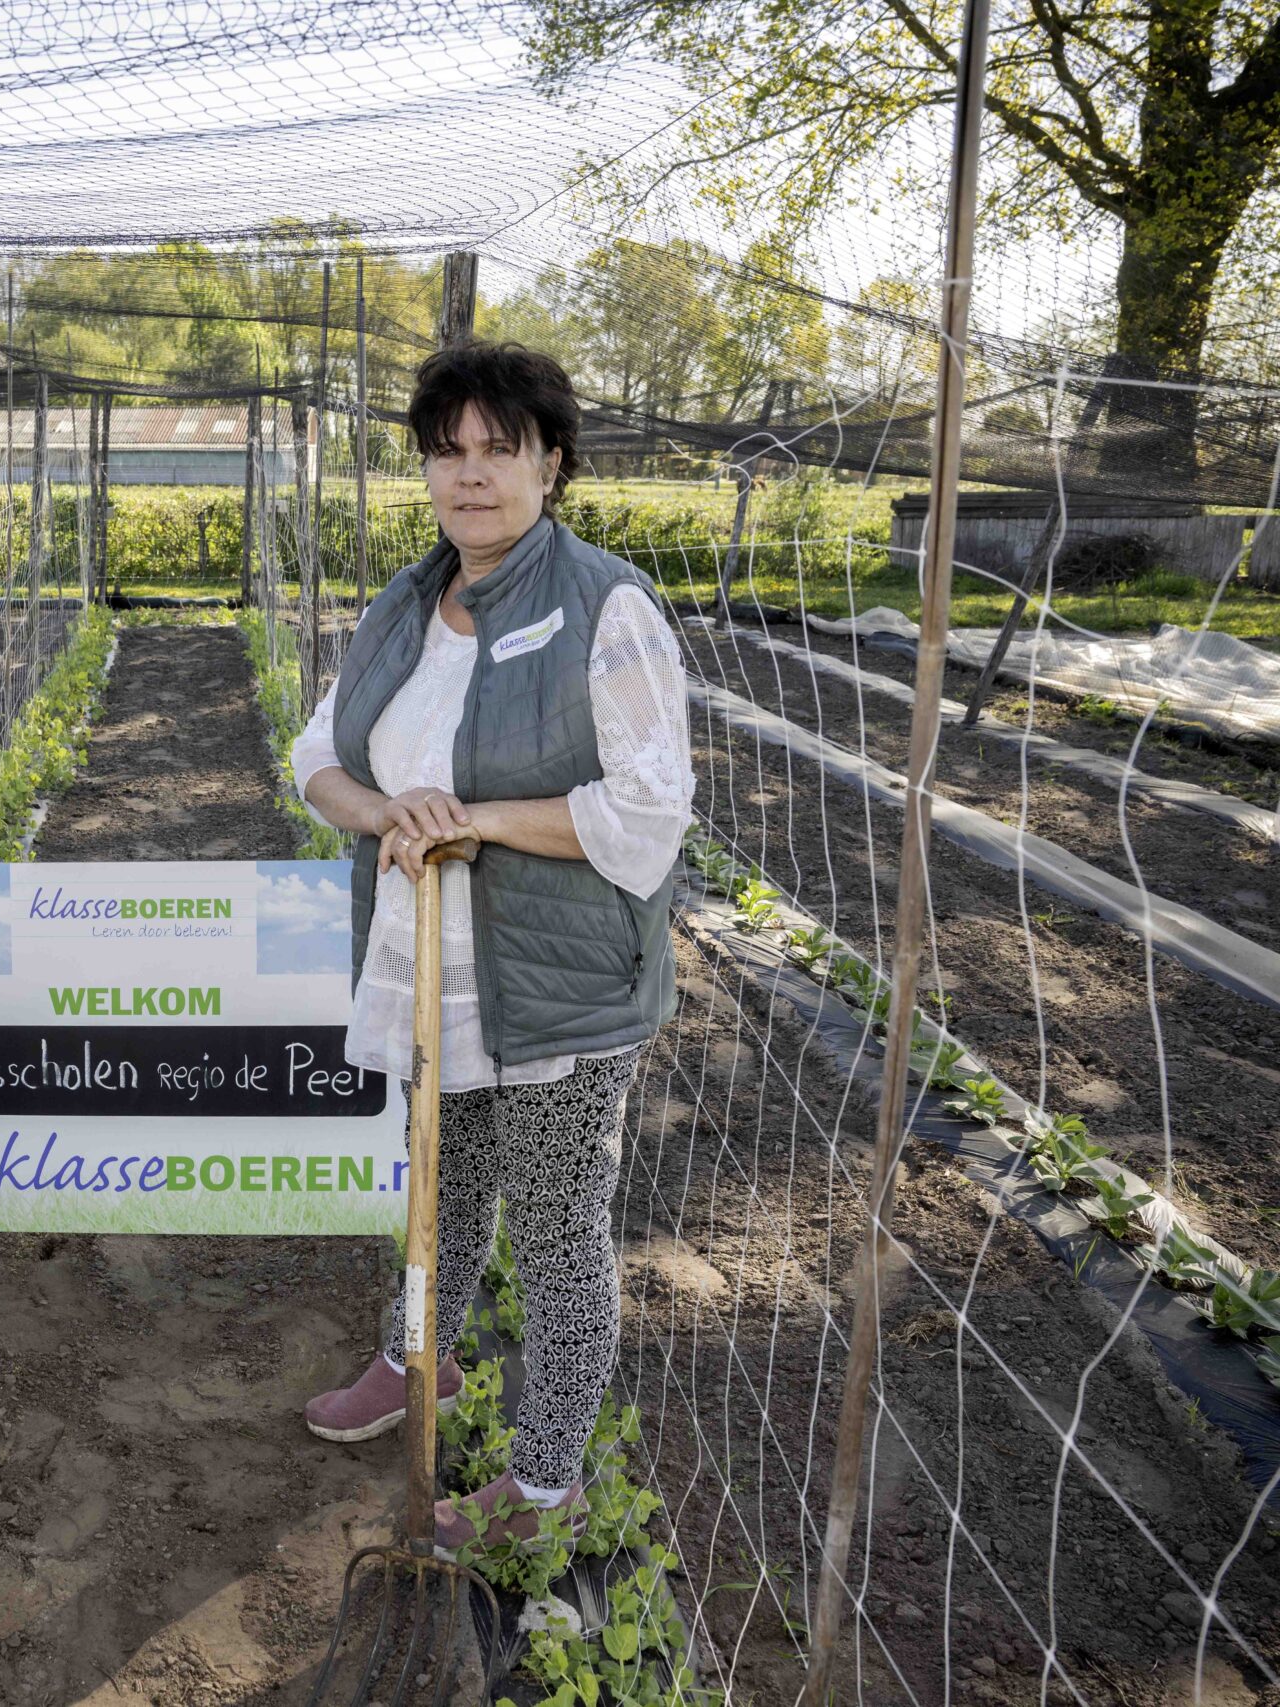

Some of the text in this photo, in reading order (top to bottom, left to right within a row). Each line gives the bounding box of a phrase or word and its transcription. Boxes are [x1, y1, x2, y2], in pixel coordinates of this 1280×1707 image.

[30, 887, 232, 920] klasseBOEREN
[92, 923, 233, 938] Leren door beleven!
[48, 987, 222, 1016] WELKOM
[234, 1055, 268, 1092] de
